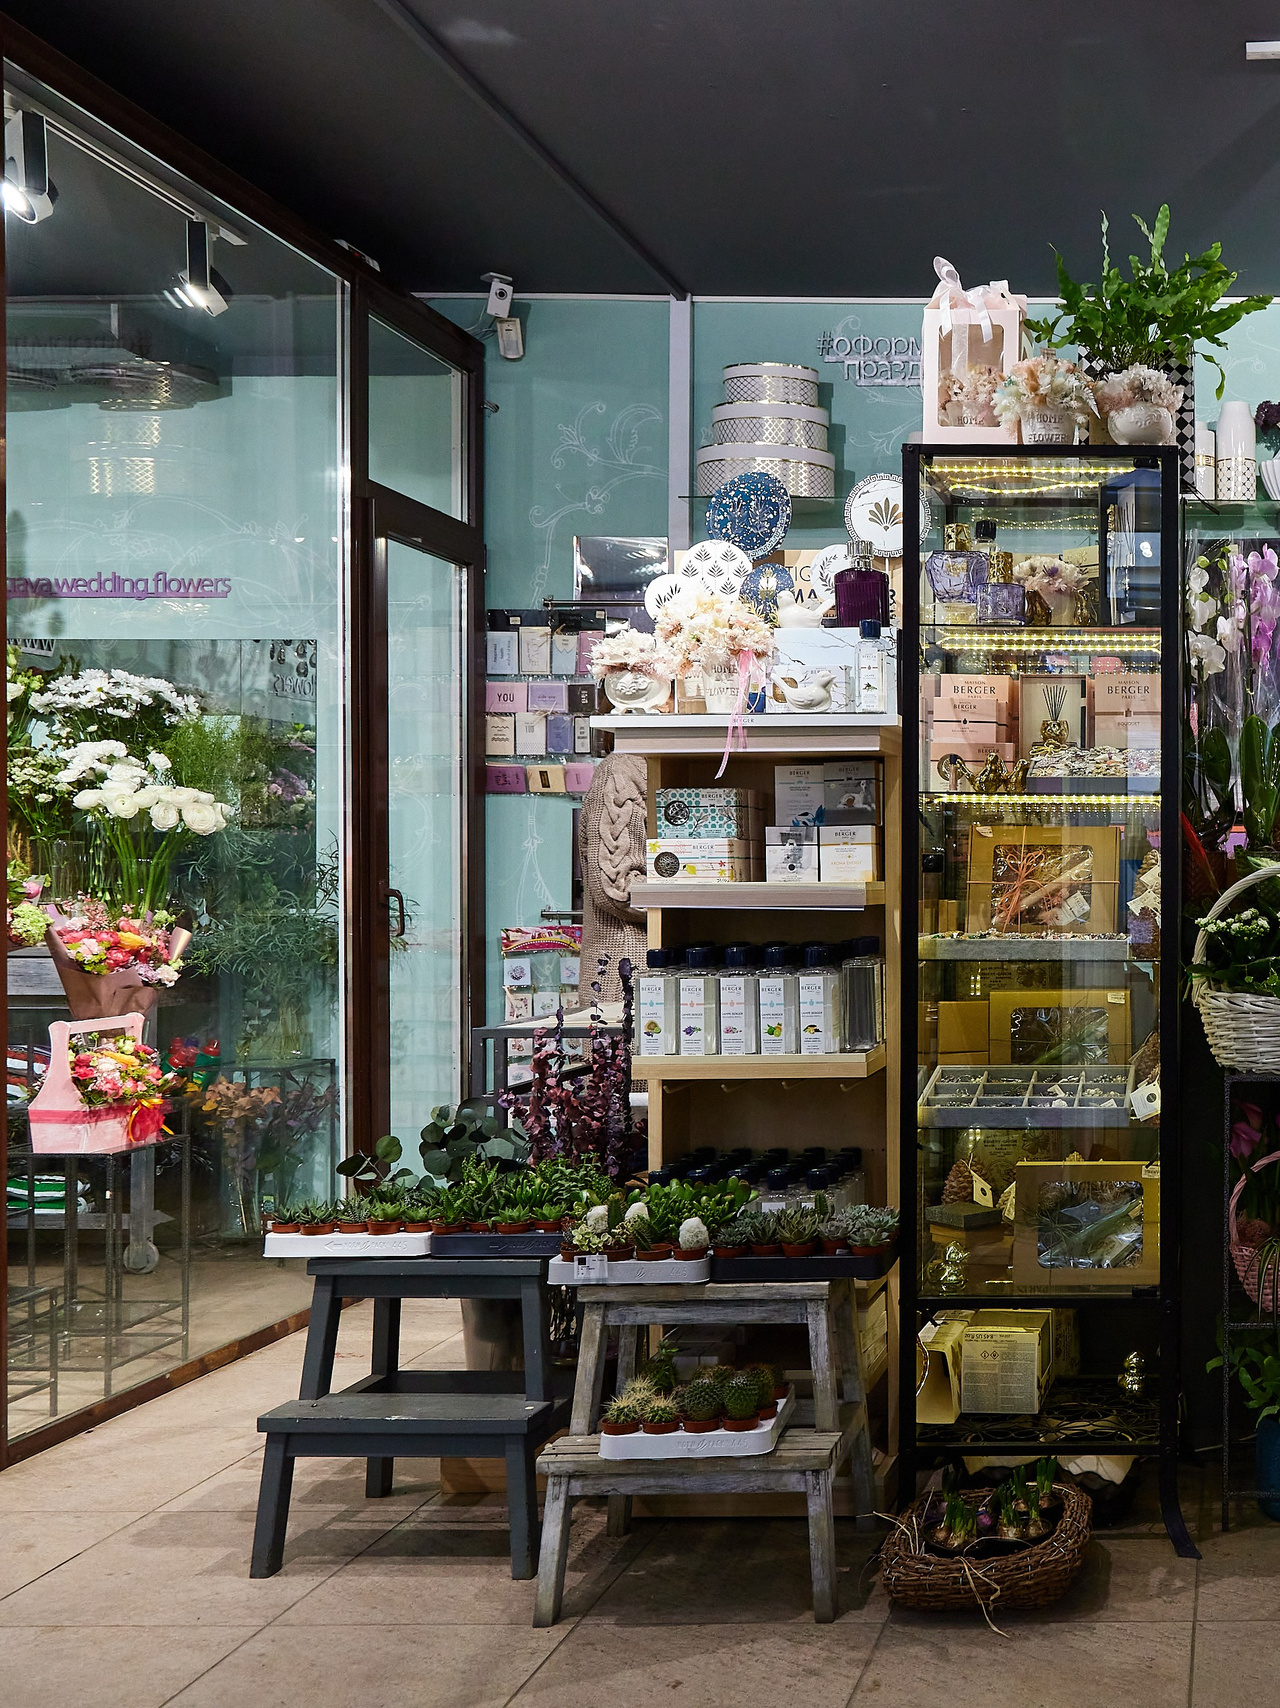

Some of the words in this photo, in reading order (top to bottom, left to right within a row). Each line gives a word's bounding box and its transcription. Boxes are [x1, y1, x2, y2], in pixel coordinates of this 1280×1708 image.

[54, 571, 150, 600] wedding
[153, 571, 232, 595] flowers
[953, 685, 996, 695] BERGER
[1107, 685, 1150, 695] BERGER
[497, 692, 515, 702] YOU
